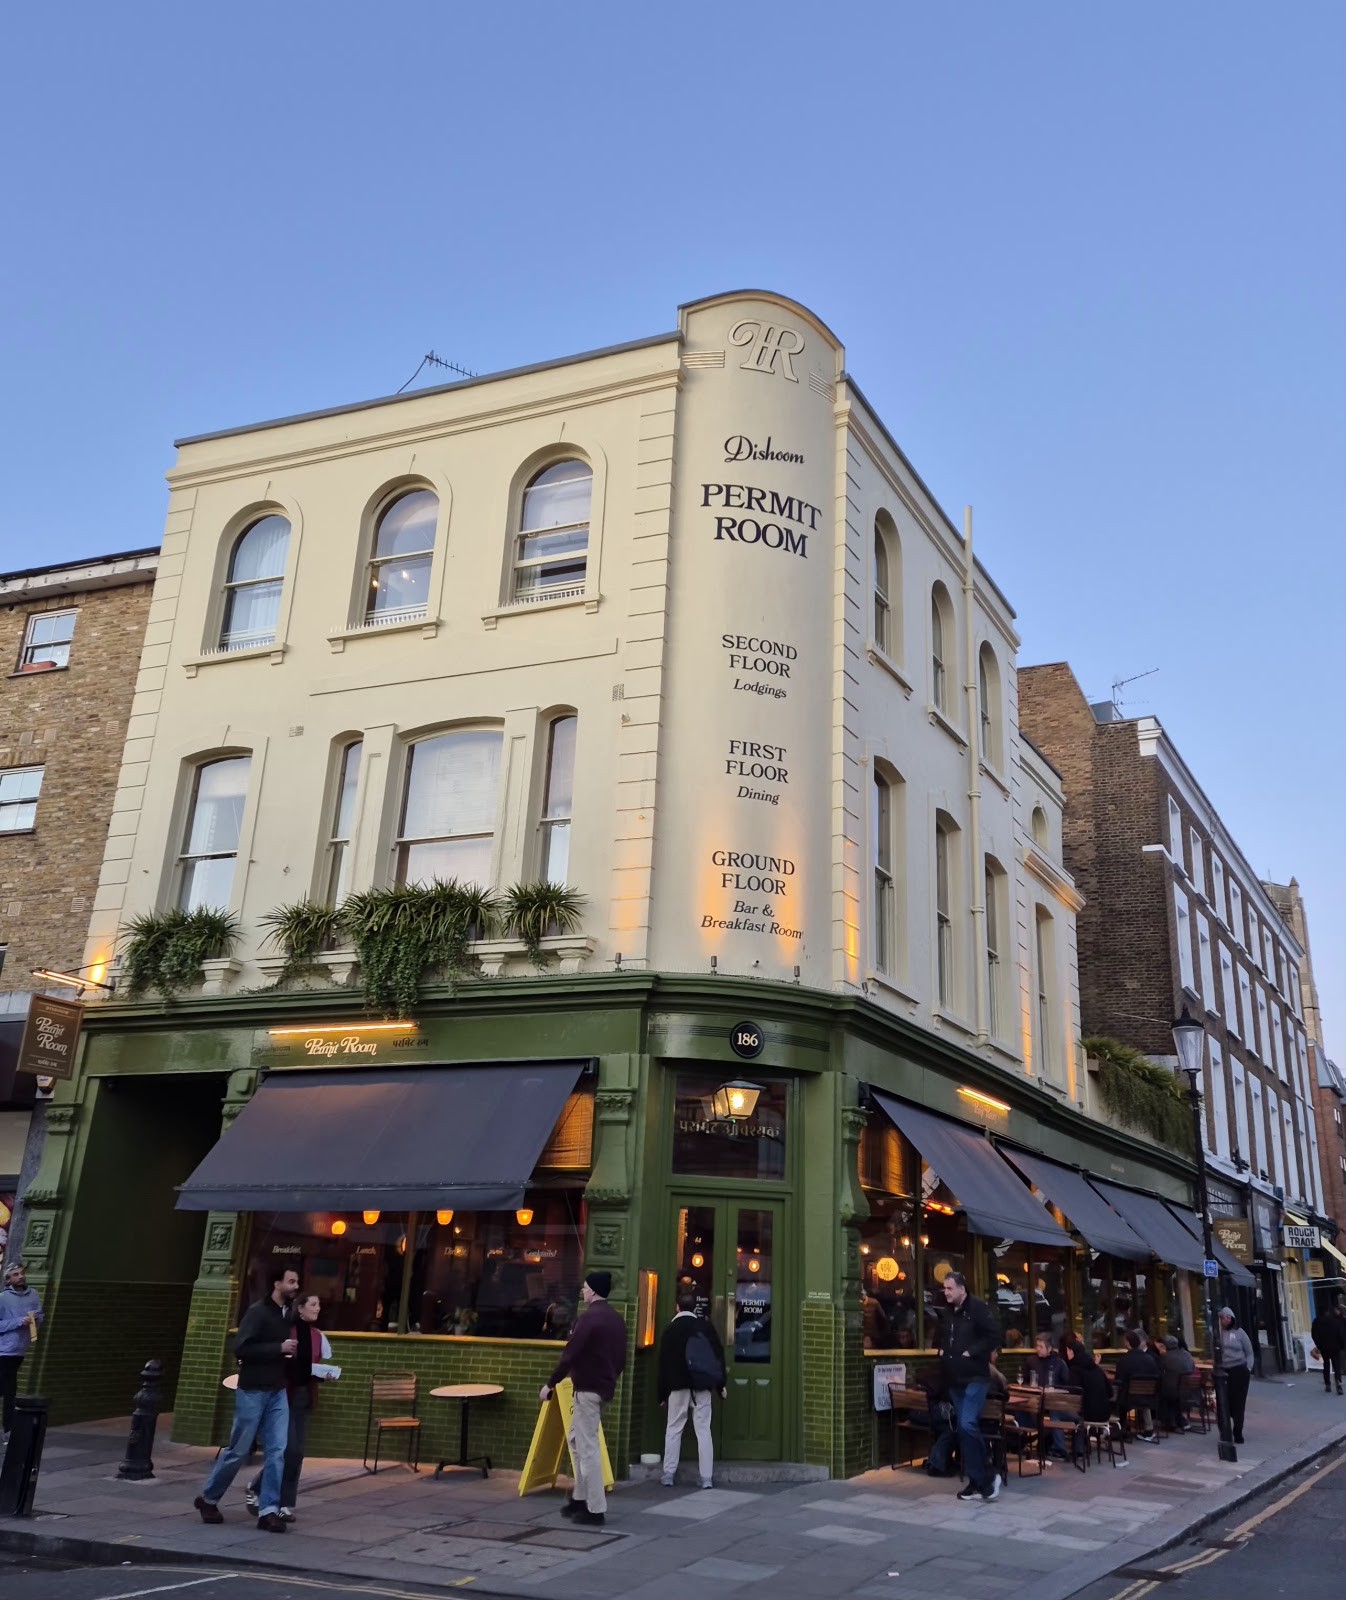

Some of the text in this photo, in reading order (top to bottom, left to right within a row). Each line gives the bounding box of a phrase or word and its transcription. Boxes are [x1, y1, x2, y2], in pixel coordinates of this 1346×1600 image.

[724, 434, 805, 464] Dishoom
[700, 483, 822, 531] PERMIT
[713, 516, 809, 559] ROOM
[721, 634, 798, 660] SECOND
[729, 654, 791, 678] FLOOR
[733, 678, 787, 698] Lodgings
[729, 740, 787, 762] FIRST
[725, 759, 789, 784] FLOOR
[737, 786, 780, 806] Dining
[711, 850, 795, 876] GROUND
[721, 872, 787, 896] FLOOR
[733, 900, 775, 918] Bar &
[700, 915, 802, 939] Breakfast Room
[36, 1016, 65, 1039] Permit
[37, 1033, 68, 1056] Room
[304, 1038, 339, 1057] Permit
[340, 1036, 377, 1056] Room
[737, 1032, 758, 1047] 186
[1288, 1226, 1315, 1237] ROUGH
[1289, 1237, 1316, 1247] TRADE
[743, 1306, 763, 1314] ROOM
